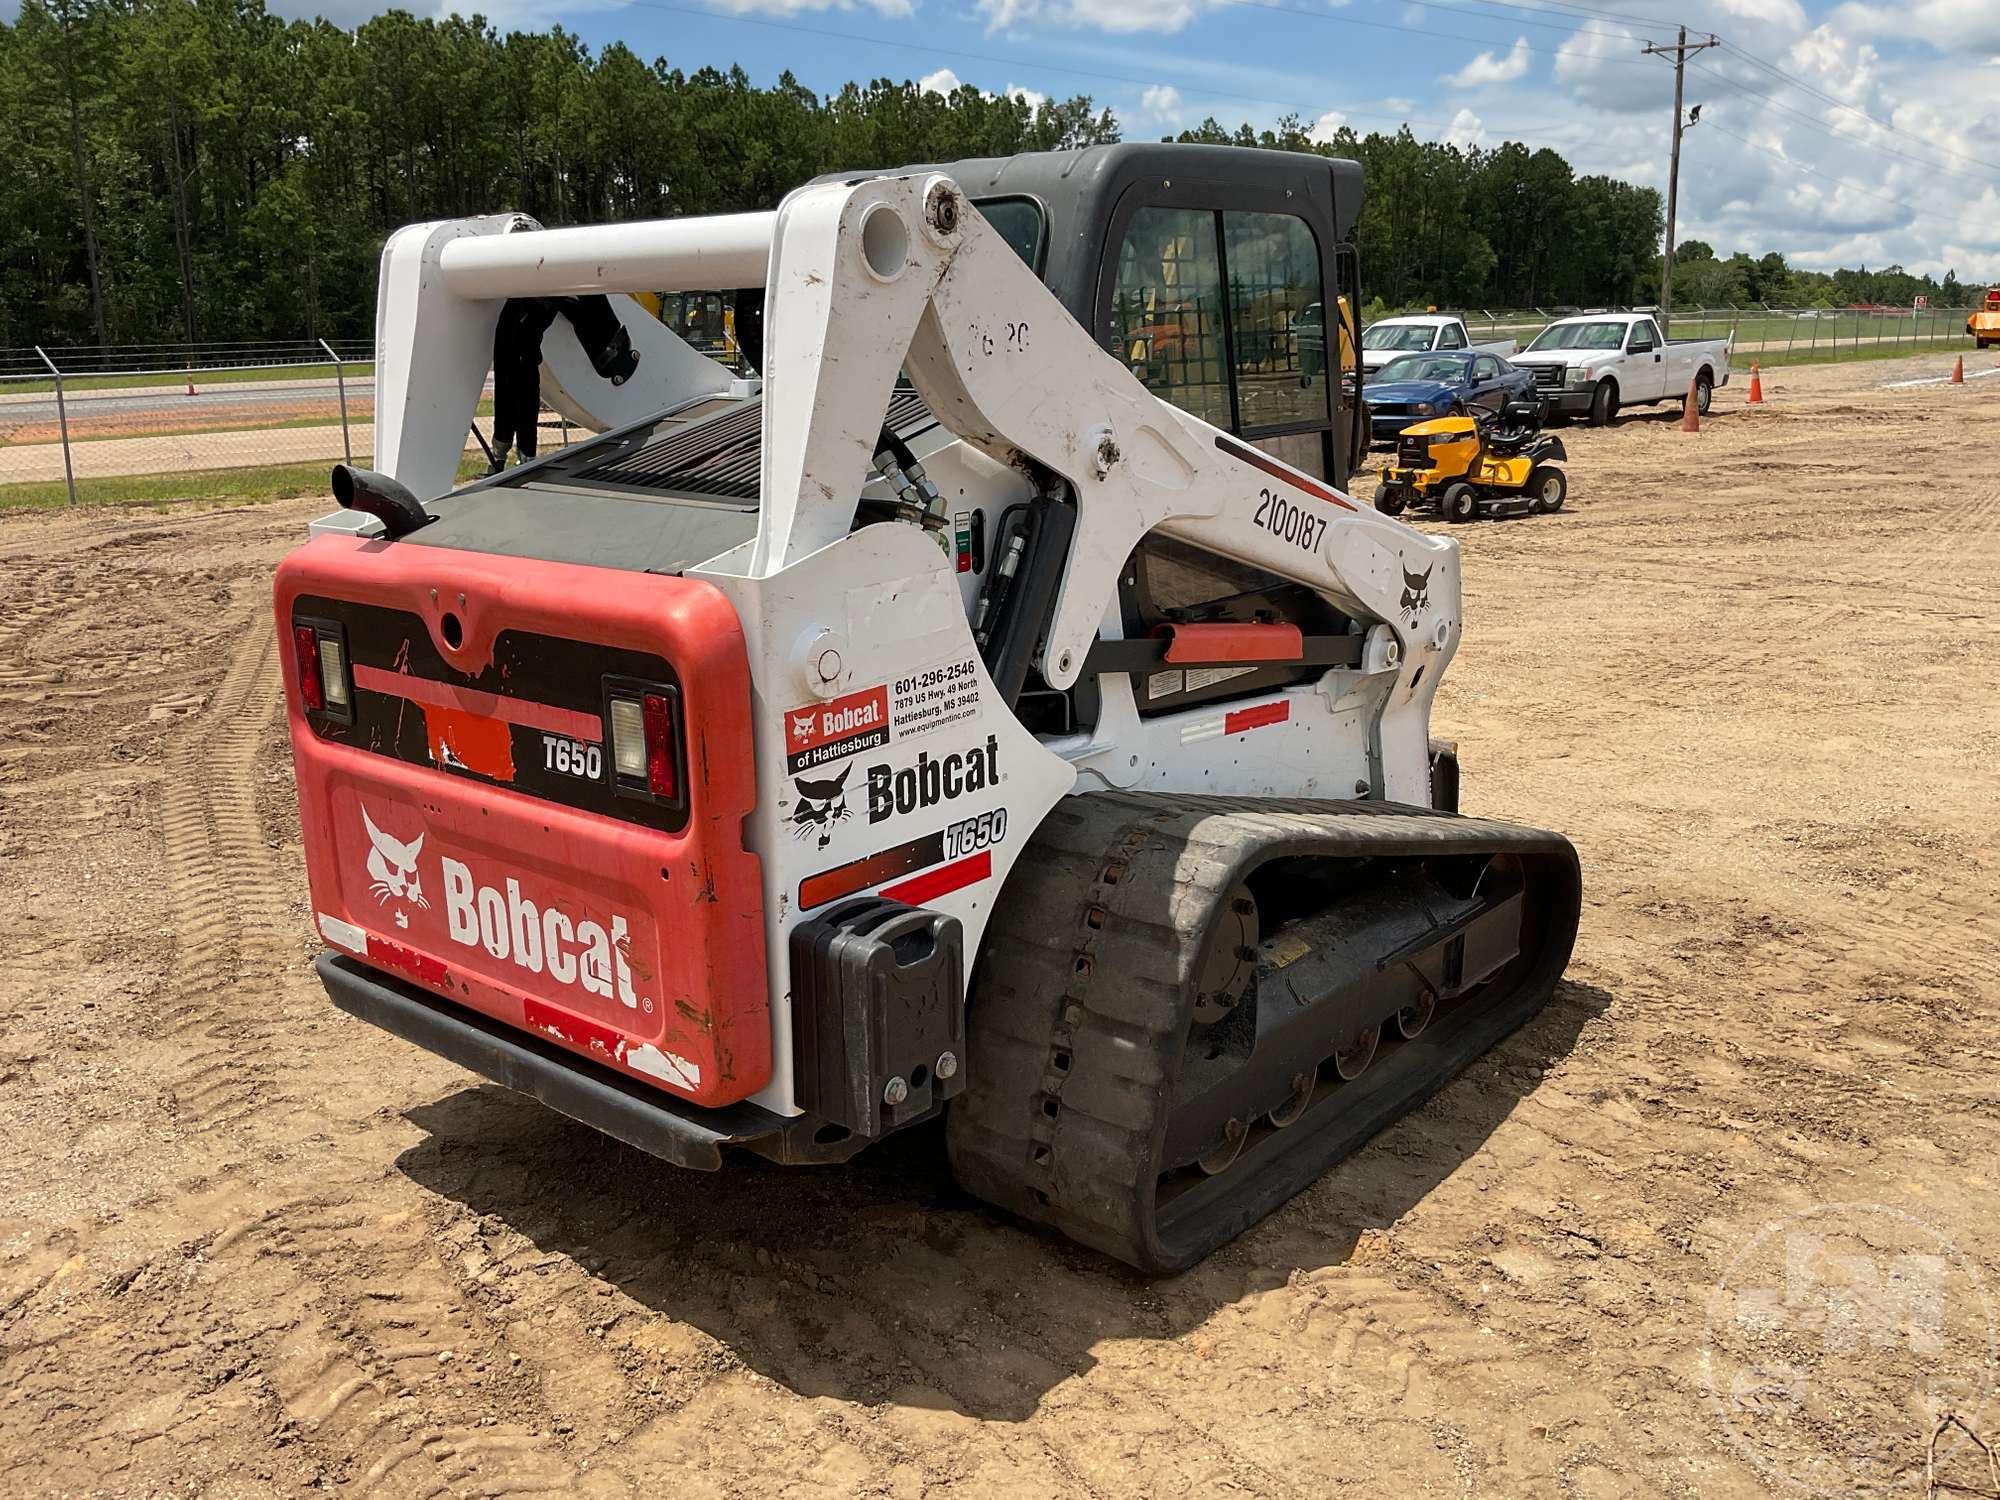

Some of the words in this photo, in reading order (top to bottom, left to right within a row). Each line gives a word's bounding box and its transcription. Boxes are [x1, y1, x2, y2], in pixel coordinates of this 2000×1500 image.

[1253, 488, 1327, 554] 2100187
[894, 696, 913, 711] 7879
[915, 692, 926, 704] US
[947, 684, 957, 694] 49
[958, 678, 978, 691] North
[895, 660, 975, 695] 601-296-2546
[822, 699, 879, 737] Bobcat
[894, 706, 942, 726] Hattiesburg,
[943, 698, 955, 711] MS
[957, 692, 979, 707] 39402
[899, 709, 976, 737] www.equipmentinc.com
[543, 735, 602, 780] T650
[797, 751, 810, 768] of
[813, 733, 881, 763] Hattiesburg
[868, 734, 1000, 825] Bobcat
[946, 807, 1008, 861] T650
[441, 855, 637, 1009] Bobcat
